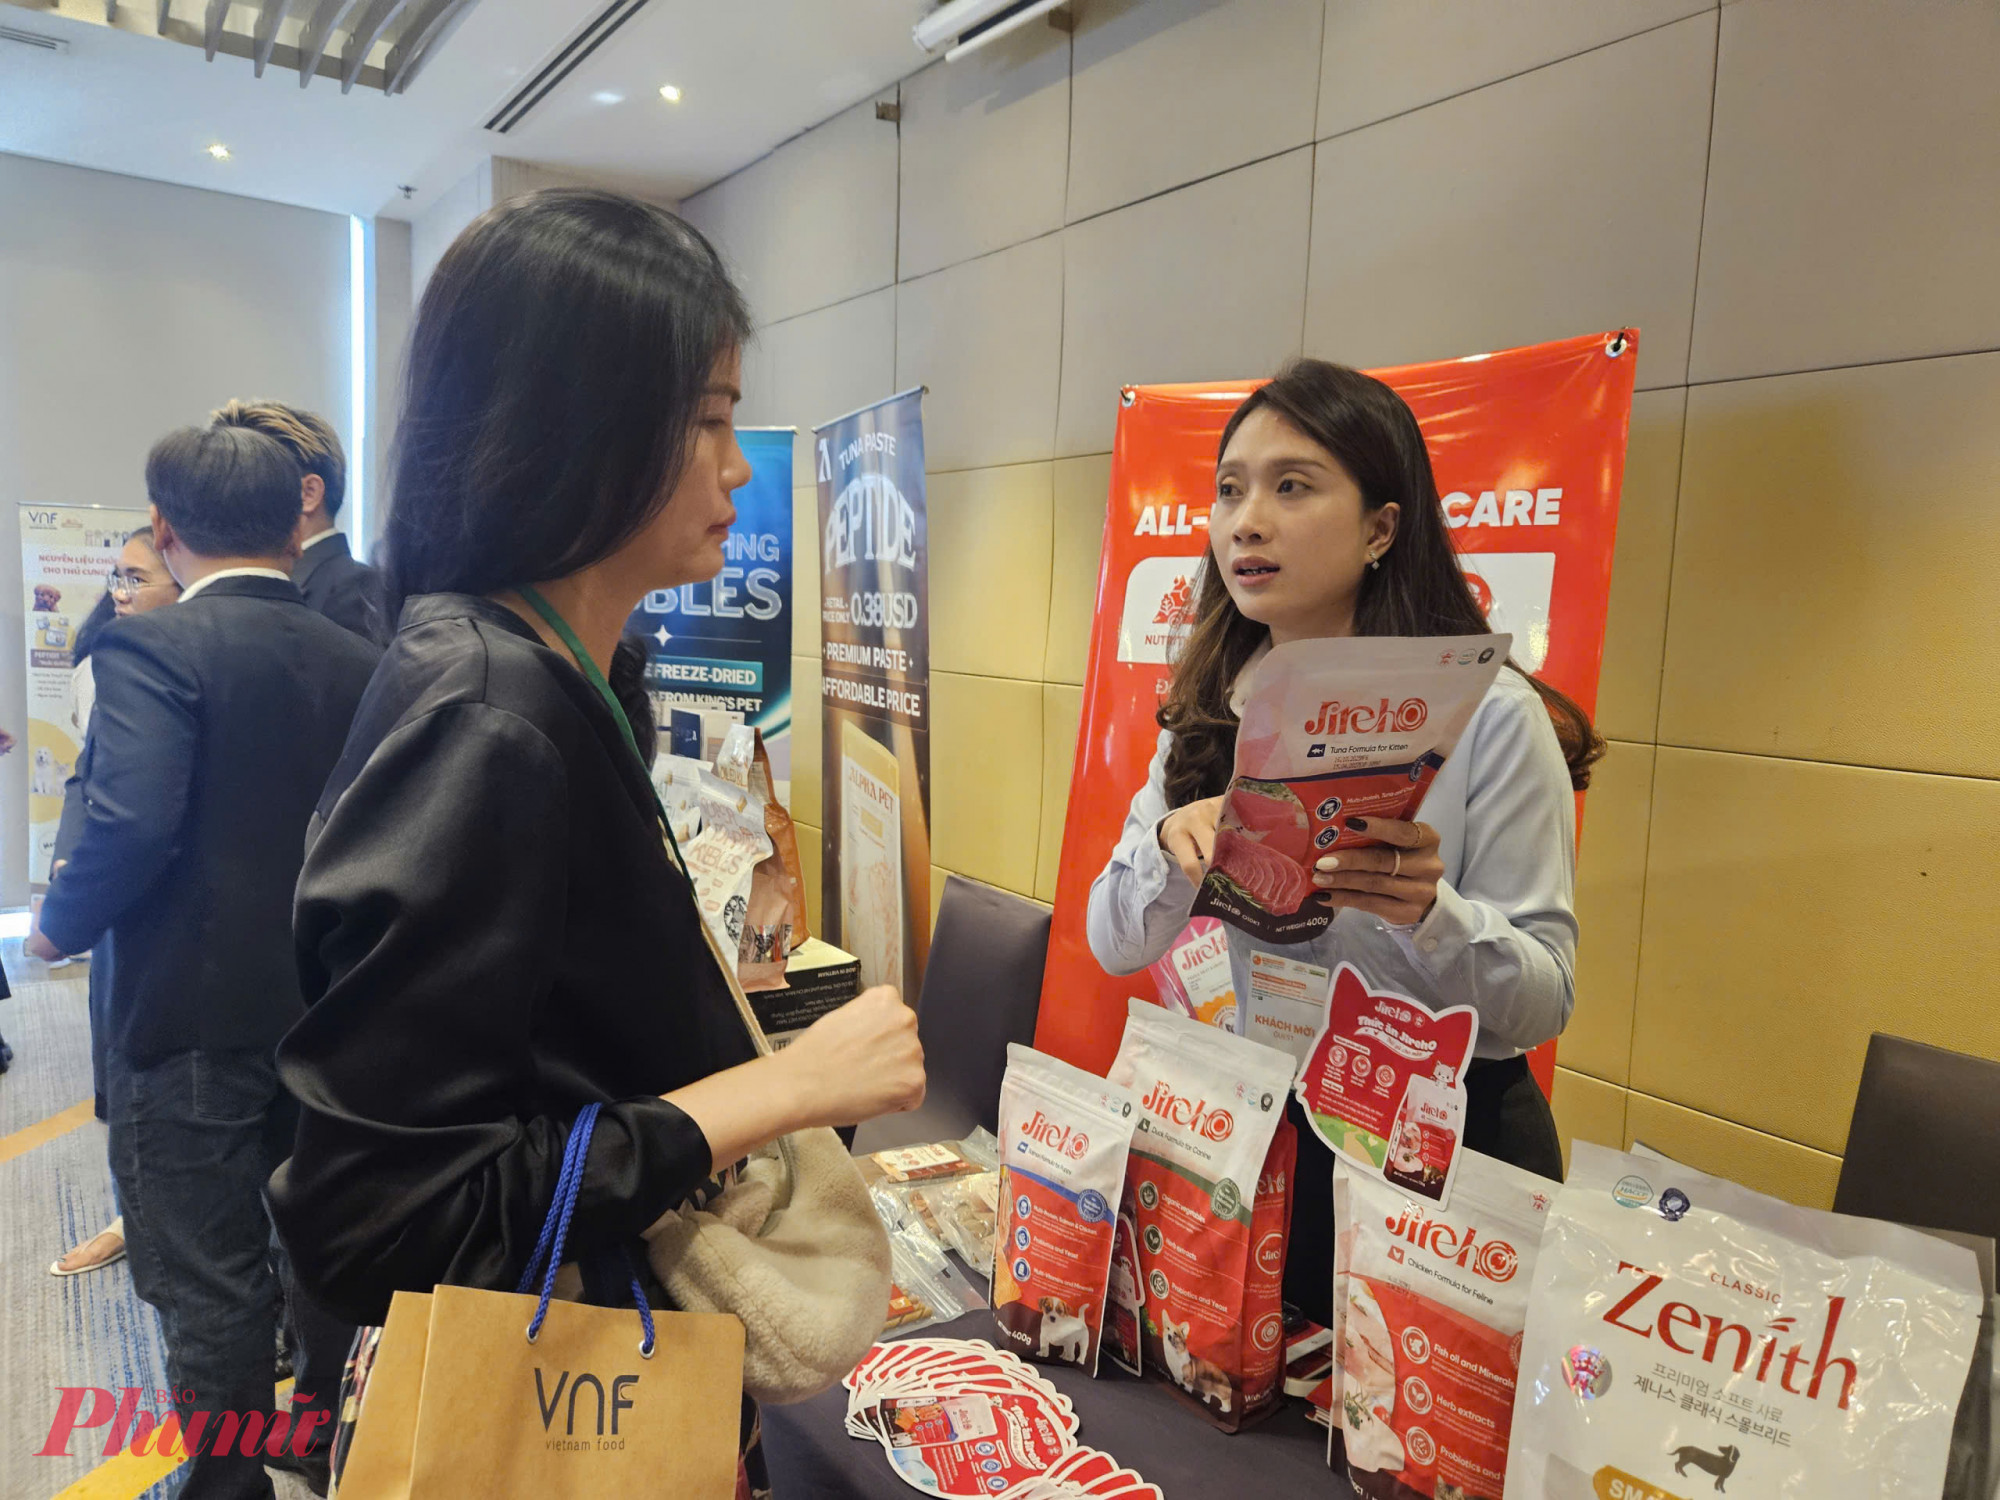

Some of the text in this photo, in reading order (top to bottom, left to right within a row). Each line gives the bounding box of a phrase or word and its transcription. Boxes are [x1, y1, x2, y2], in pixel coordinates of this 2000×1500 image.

[839, 431, 897, 471] TUNA PASTE
[825, 472, 917, 575] PEPTIDE
[1133, 487, 1563, 536] ALL- CARE
[721, 533, 780, 562] ING
[826, 641, 907, 672] PREMIUM PASTE
[654, 663, 757, 686] FREEZE-DRIED
[737, 698, 763, 712] PET
[822, 676, 921, 717] AFFORDABLE PRICE
[1330, 743, 1409, 754] Tuna Formula for Kitten
[878, 787, 895, 815] PET
[1306, 916, 1329, 927] 400g
[1254, 1013, 1316, 1039] KHÁCH MỜI
[1151, 1126, 1164, 1138] Duck
[1164, 1132, 1185, 1148] Formula
[1192, 1146, 1212, 1161] Canine
[1407, 1257, 1494, 1306] Chicken Formula for Feline
[1709, 1271, 1783, 1305] CLASSIC
[1198, 1295, 1211, 1305] and
[1211, 1299, 1228, 1313] Yeast
[1012, 1330, 1032, 1346] 400g
[1602, 1260, 1858, 1411] Zenith
[1433, 1343, 1516, 1389] Fish oil and Minerals
[1652, 1362, 1784, 1424] 프리미엄 소프트 사료
[1436, 1394, 1496, 1429] Herb extracts
[1633, 1374, 1792, 1448] 제니스 클래식 스몰브리드
[545, 1437, 626, 1451] vietnam food
[1440, 1445, 1501, 1480] Probiotics and
